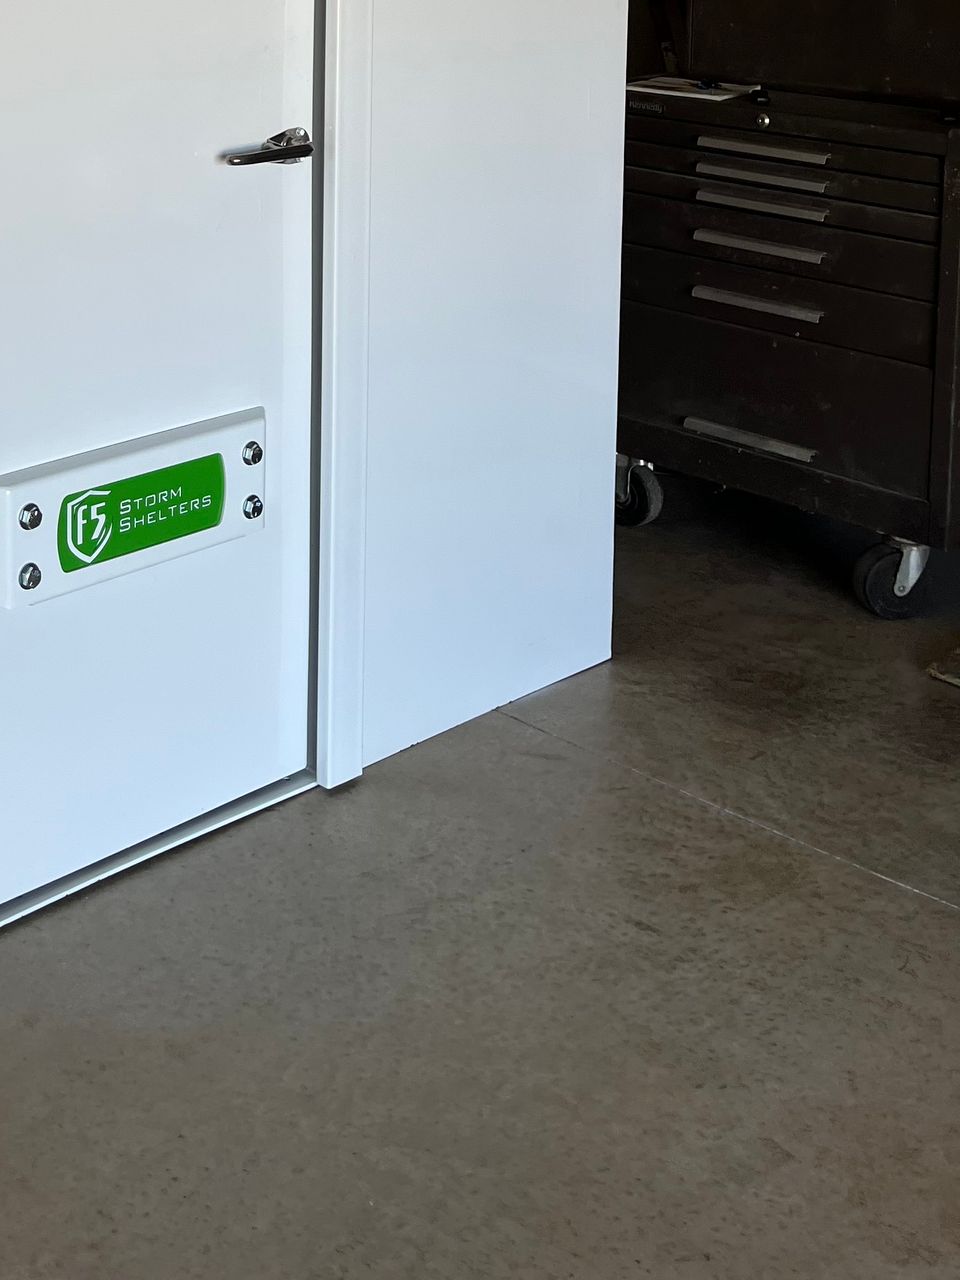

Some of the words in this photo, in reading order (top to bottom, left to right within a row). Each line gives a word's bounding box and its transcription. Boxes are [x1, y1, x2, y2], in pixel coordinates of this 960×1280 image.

[119, 486, 183, 516] STORM
[119, 495, 212, 533] SHELTERS
[77, 502, 106, 545] F5
